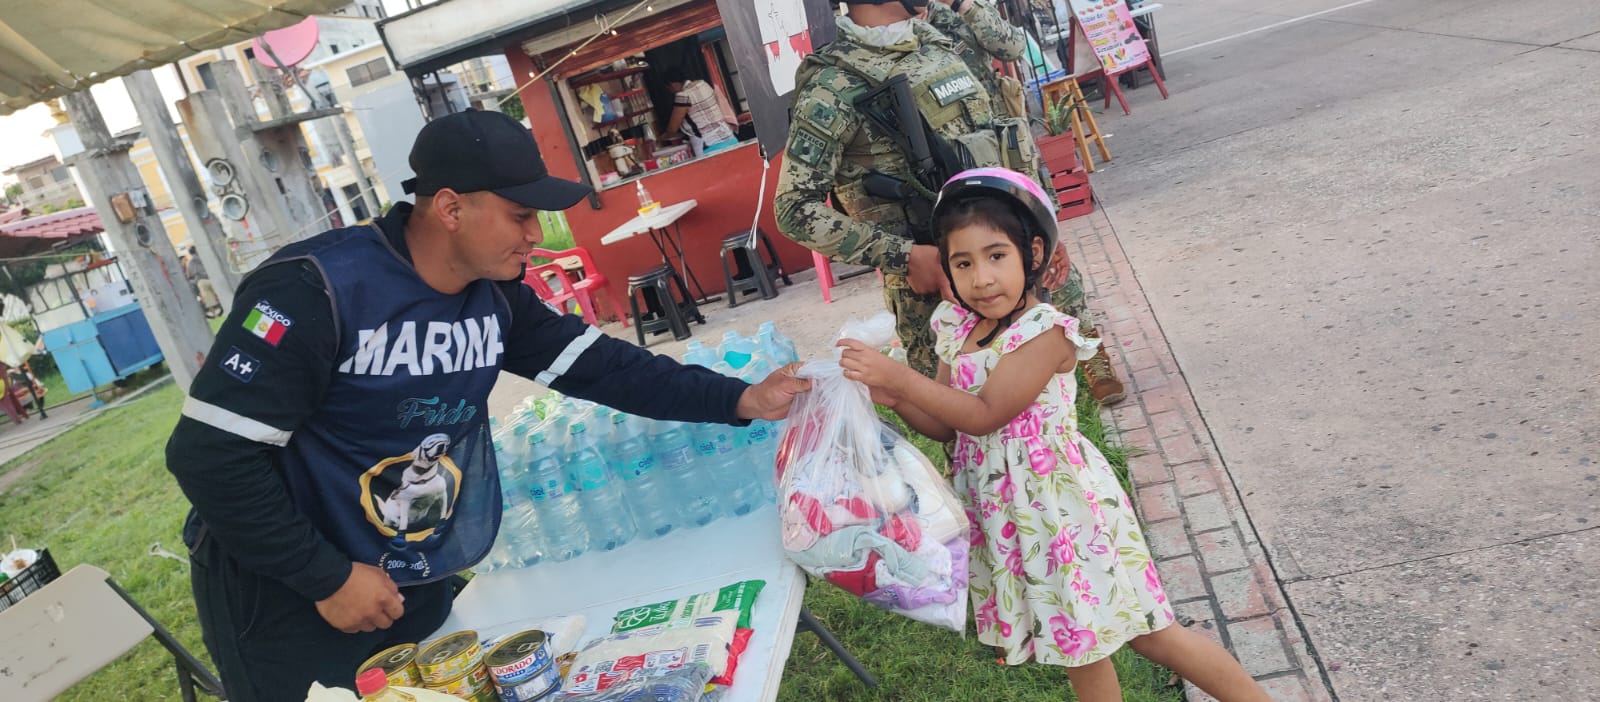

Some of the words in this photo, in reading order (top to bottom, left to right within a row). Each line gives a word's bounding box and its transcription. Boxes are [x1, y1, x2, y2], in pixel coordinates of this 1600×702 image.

[933, 74, 975, 101] MARINA
[254, 300, 291, 327] MÉXICO
[338, 313, 504, 376] MARINA
[224, 353, 253, 375] A+
[396, 396, 478, 429] Frida
